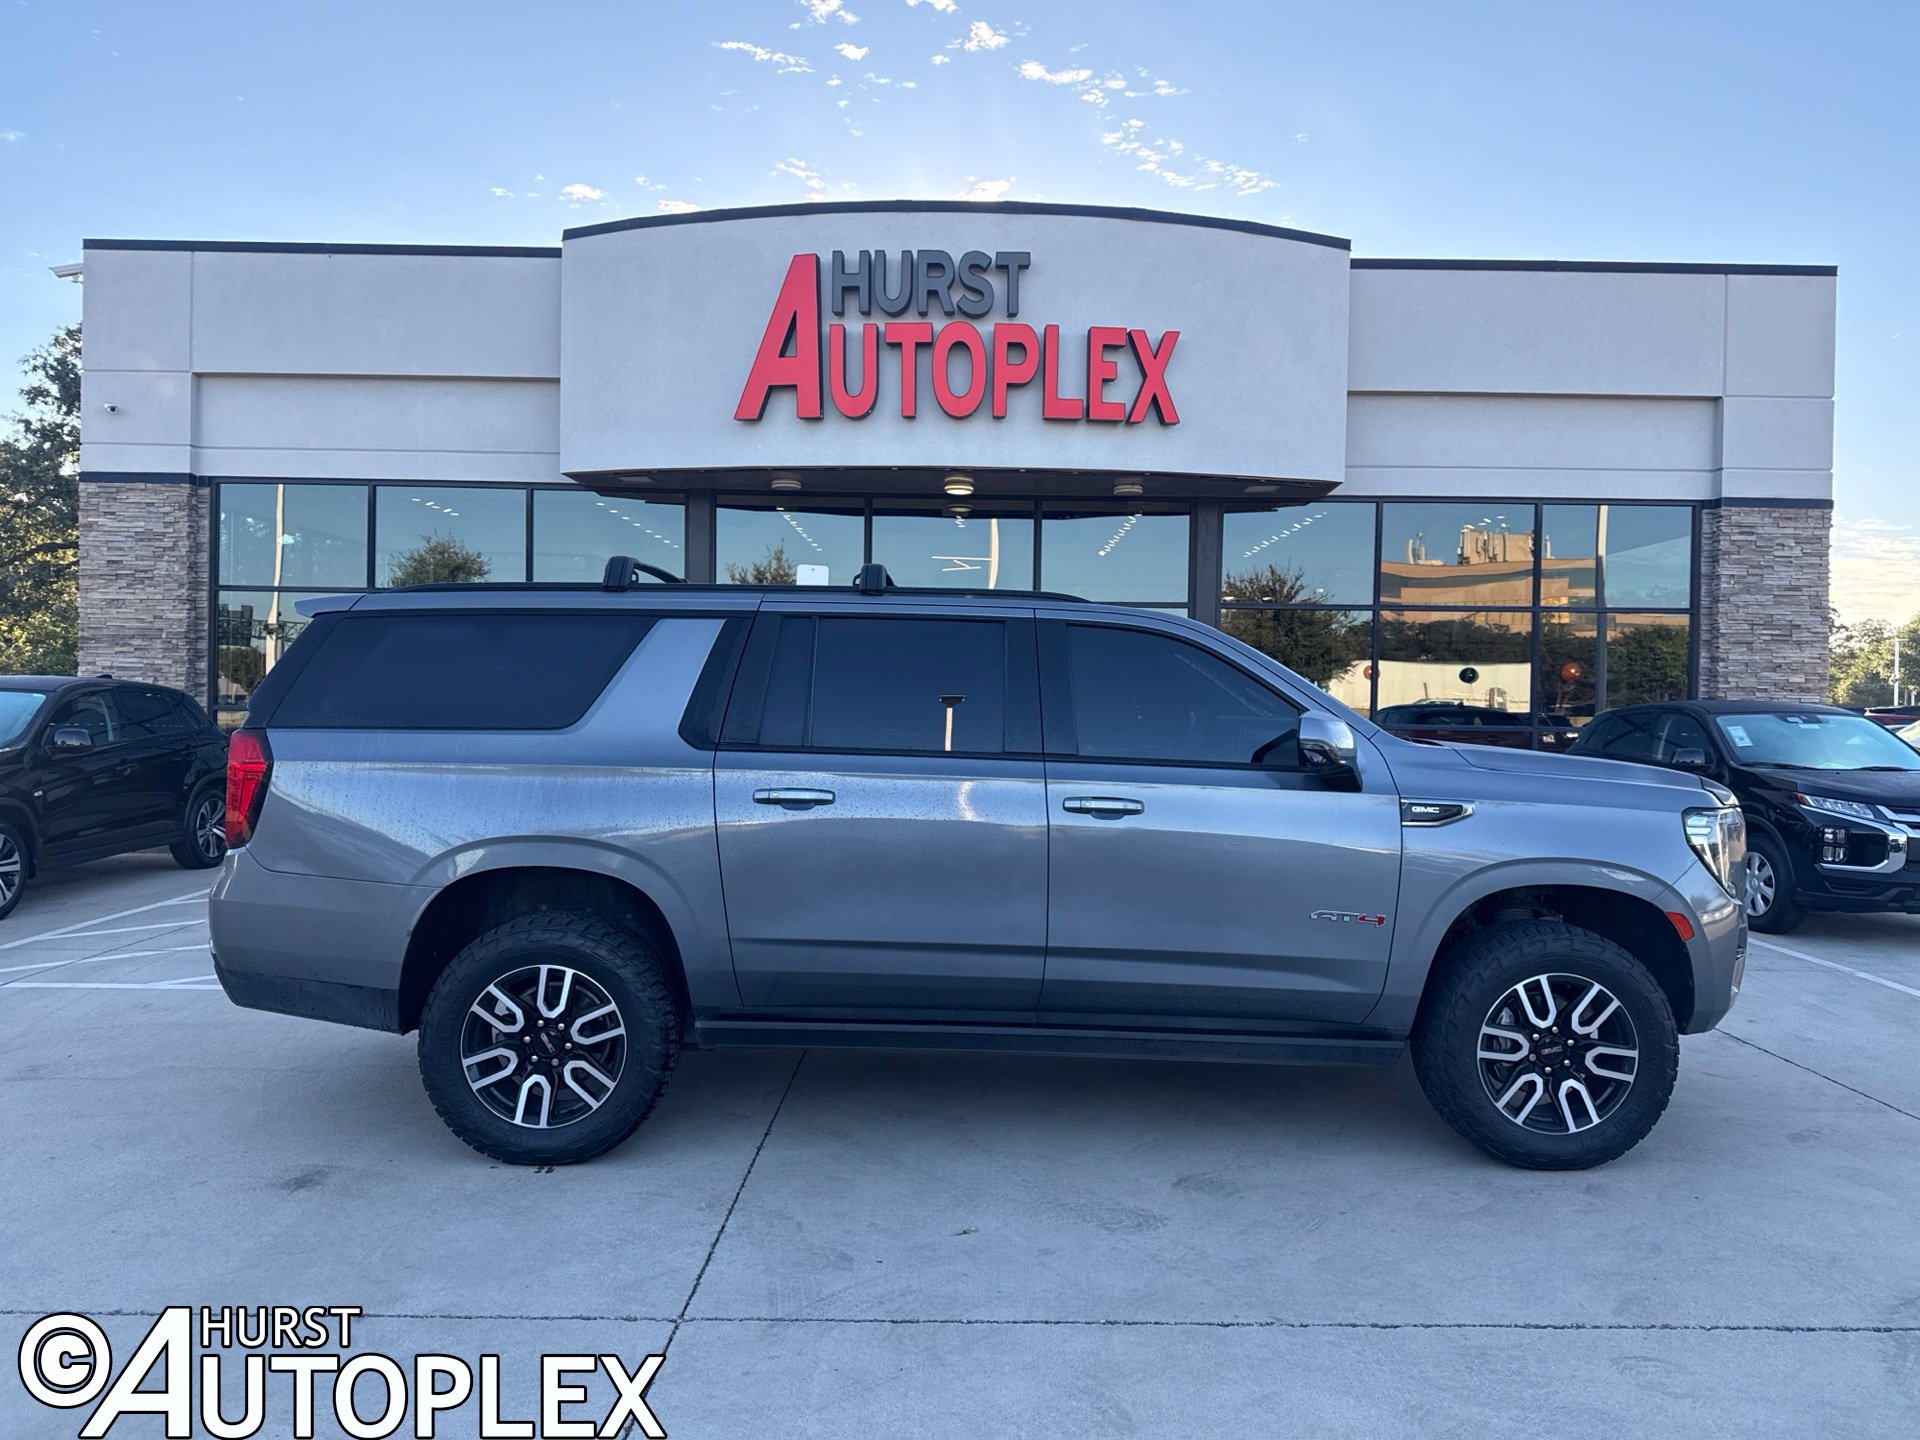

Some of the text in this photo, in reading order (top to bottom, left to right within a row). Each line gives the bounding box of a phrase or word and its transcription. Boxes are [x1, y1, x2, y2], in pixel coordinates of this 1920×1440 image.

[831, 250, 1031, 318] HURST
[734, 253, 1181, 425] AUTOPLEX
[1411, 805, 1440, 814] GMC
[1310, 909, 1386, 927] AT4
